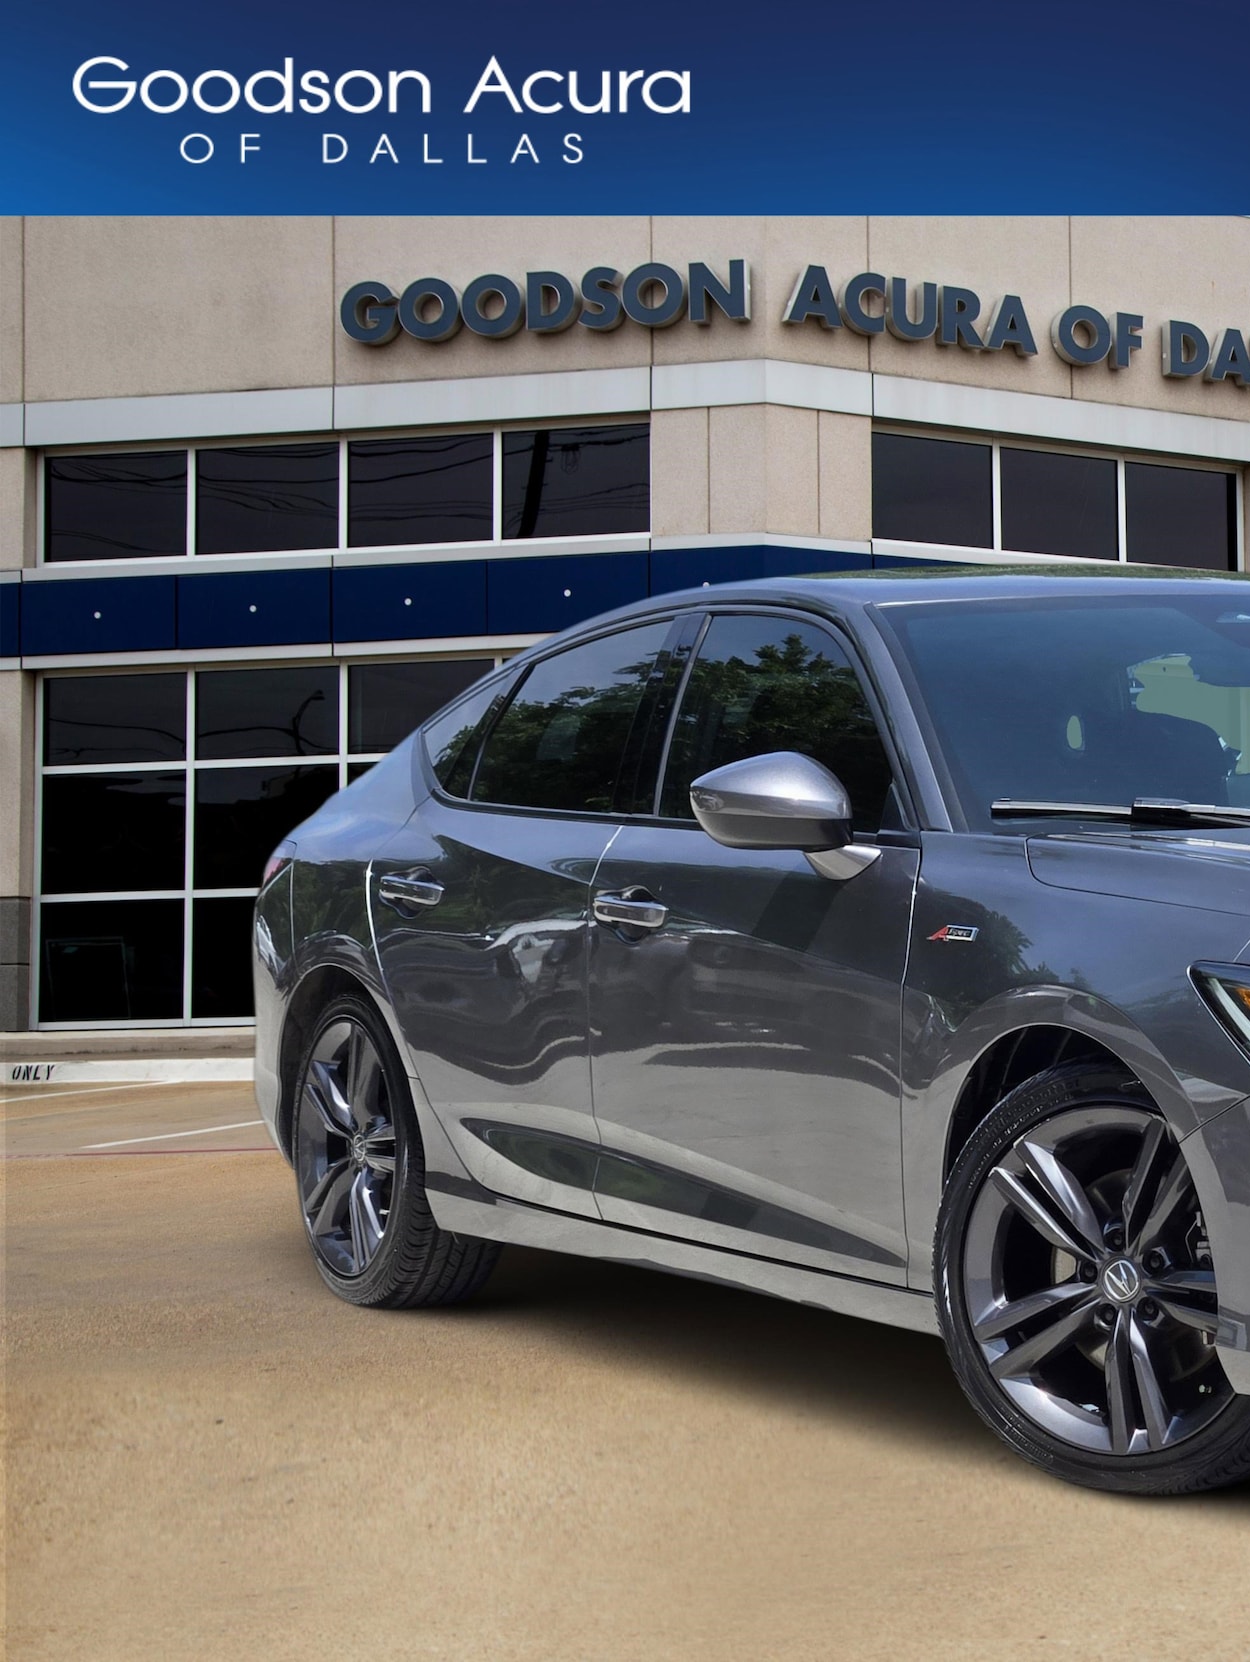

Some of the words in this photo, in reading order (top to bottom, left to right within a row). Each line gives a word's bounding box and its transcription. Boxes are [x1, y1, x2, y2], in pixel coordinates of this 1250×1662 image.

[340, 258, 751, 345] GOODSON
[782, 264, 1038, 357] ACURA
[1051, 304, 1144, 370] OF
[12, 1064, 56, 1081] ONLY
